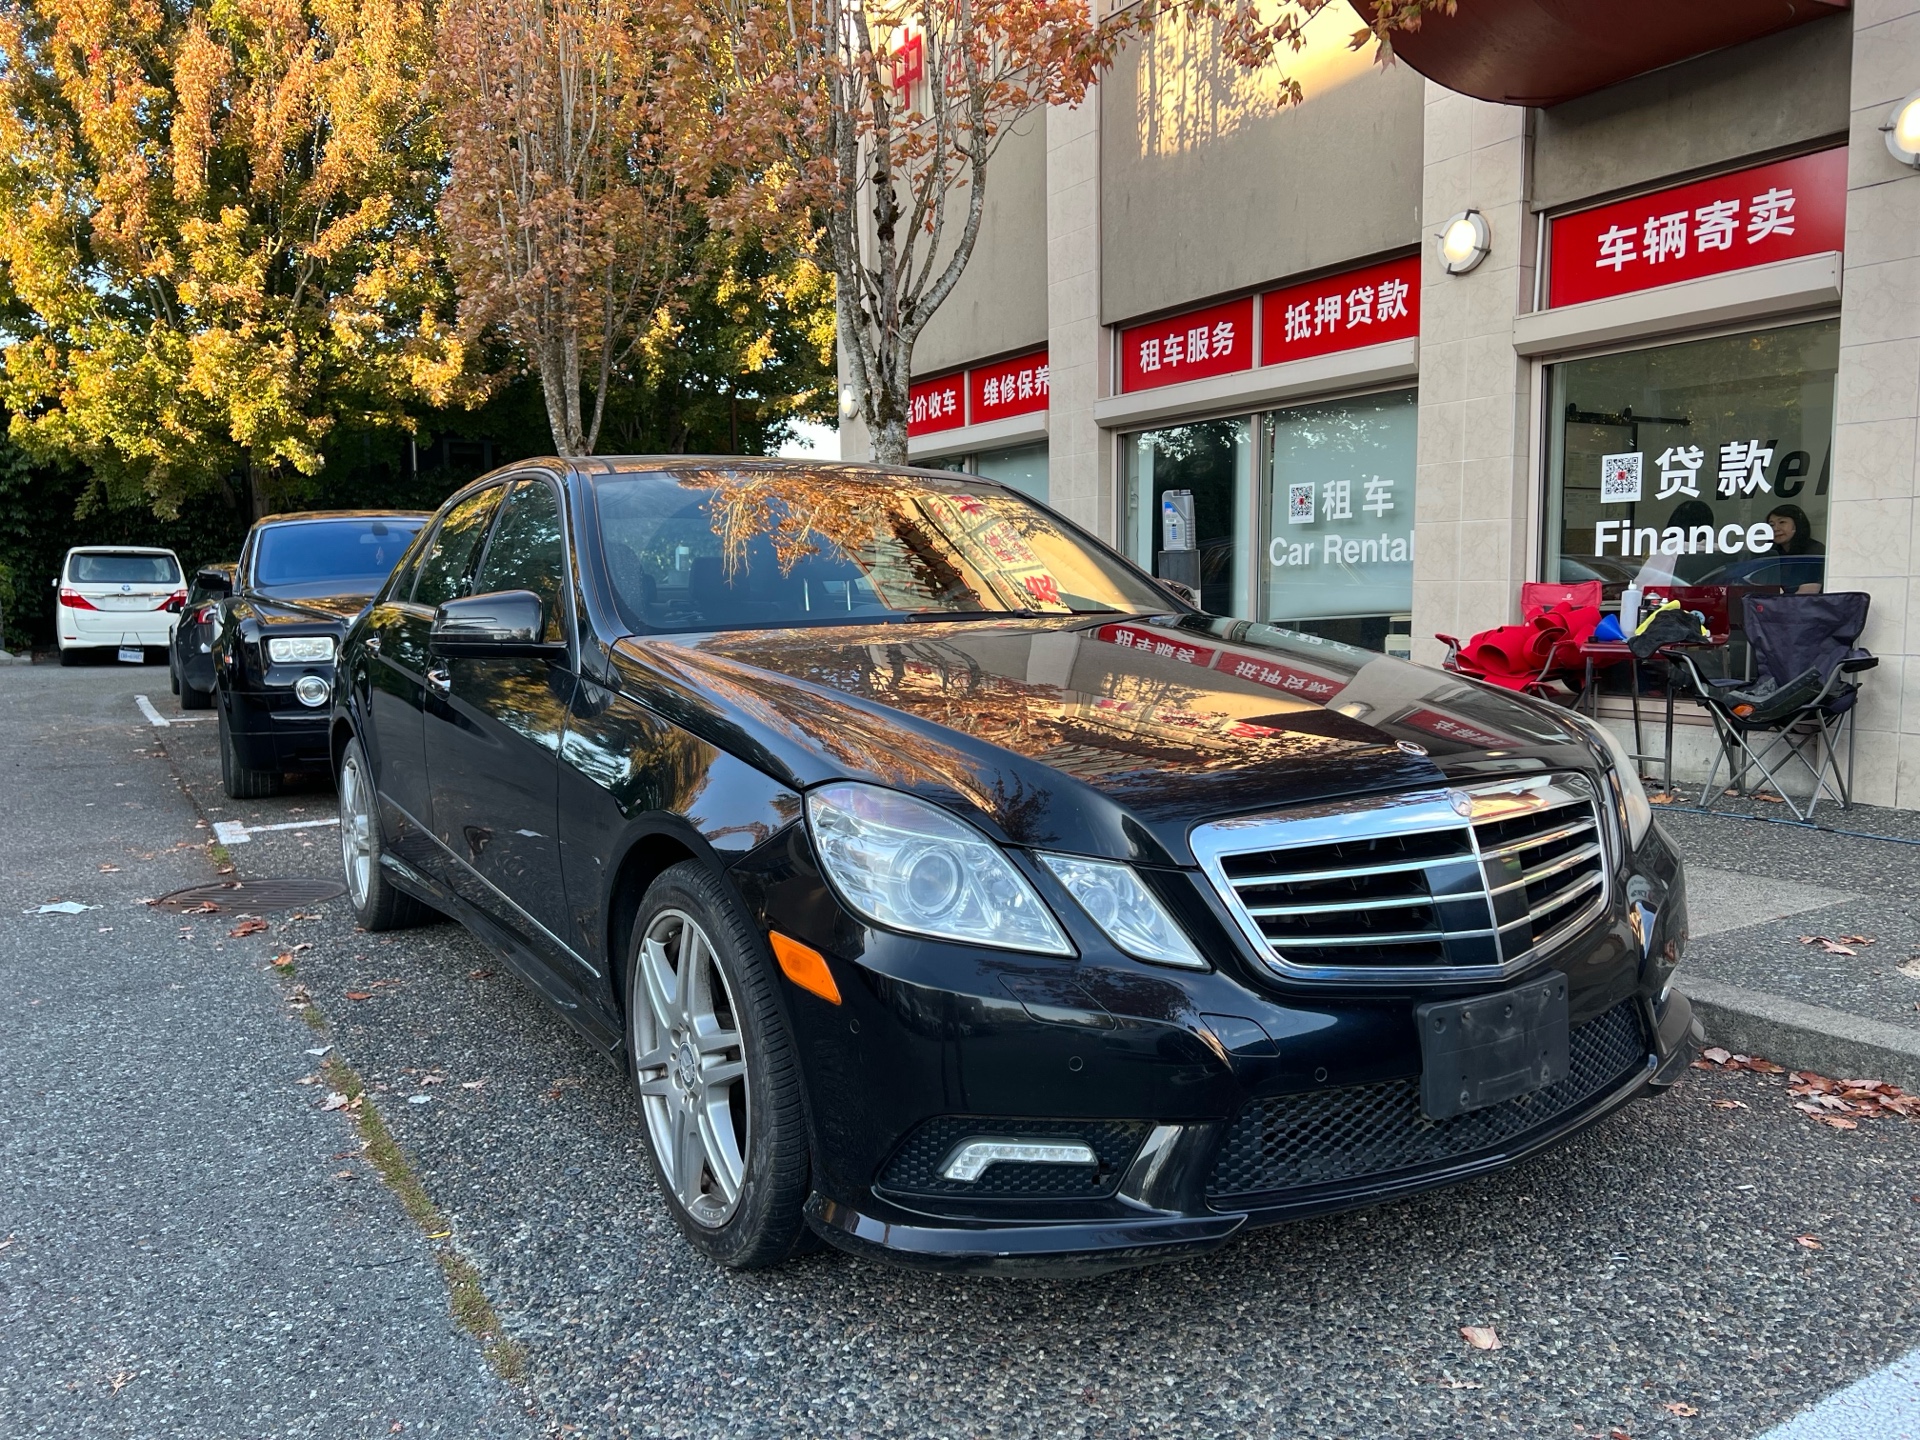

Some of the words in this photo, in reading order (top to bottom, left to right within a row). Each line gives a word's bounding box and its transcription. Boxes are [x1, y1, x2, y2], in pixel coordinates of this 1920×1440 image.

[1595, 187, 1797, 272] 车辆寄卖
[1284, 278, 1409, 343] 抵押贷款
[1140, 321, 1235, 373] 租车服务
[983, 364, 1050, 406] 维修保养
[1654, 439, 1774, 500] 贷款
[1321, 475, 1395, 521] 租车
[1268, 536, 1315, 567] Car
[1323, 530, 1415, 565] Rental
[1594, 519, 1775, 558] Finance
